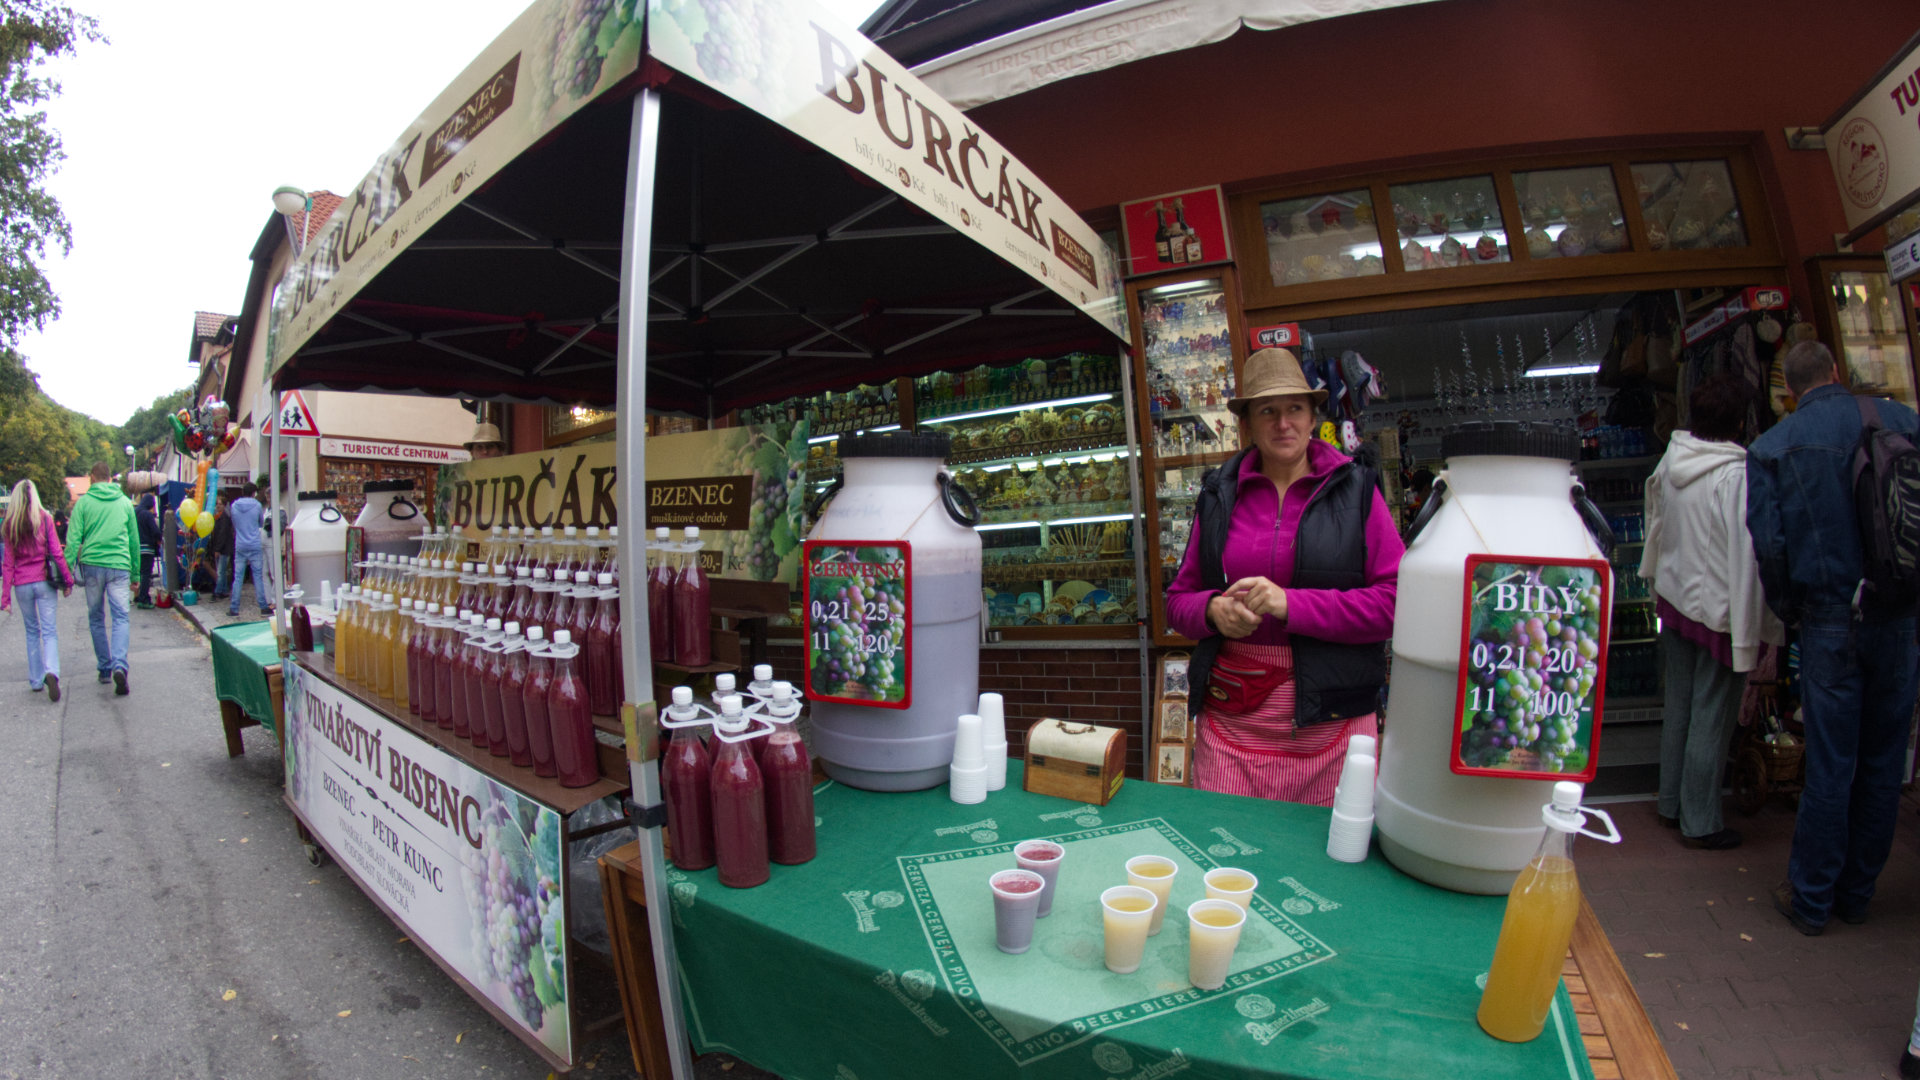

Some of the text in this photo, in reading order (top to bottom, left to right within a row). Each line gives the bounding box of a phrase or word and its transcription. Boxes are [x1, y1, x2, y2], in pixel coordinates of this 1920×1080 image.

[434, 73, 504, 154] BZENEC
[809, 20, 1050, 252] BURČÁK
[290, 132, 422, 323] BURČÁK
[342, 443, 449, 460] TURISTICKÉ CENTRUM
[454, 455, 617, 531] BURČÁK
[650, 483, 733, 506] BZENEC
[651, 512, 694, 523] muškátové
[811, 558, 903, 578] ČERVENÝ
[865, 602, 903, 626] 25,-
[1494, 577, 1582, 615] BÍLÝ
[856, 634, 903, 658] 120,-
[1545, 648, 1597, 680] 20,-
[1531, 691, 1592, 722] 100,-
[305, 689, 483, 850] VINAŘSTVÍ BISENC
[323, 771, 356, 817] BZENEC
[372, 814, 400, 858] PETR
[403, 841, 443, 893] KUNC
[387, 863, 416, 900] MORAVA
[1257, 905, 1316, 949] CERVEZA
[906, 865, 1015, 1047] CERVEZA CERVEJA PIVO BEER
[1026, 1032, 1064, 1054] PIVO
[1072, 1011, 1128, 1033] BEER
[1141, 989, 1201, 1013] BIÈRE
[1264, 951, 1318, 975] BIRRA
